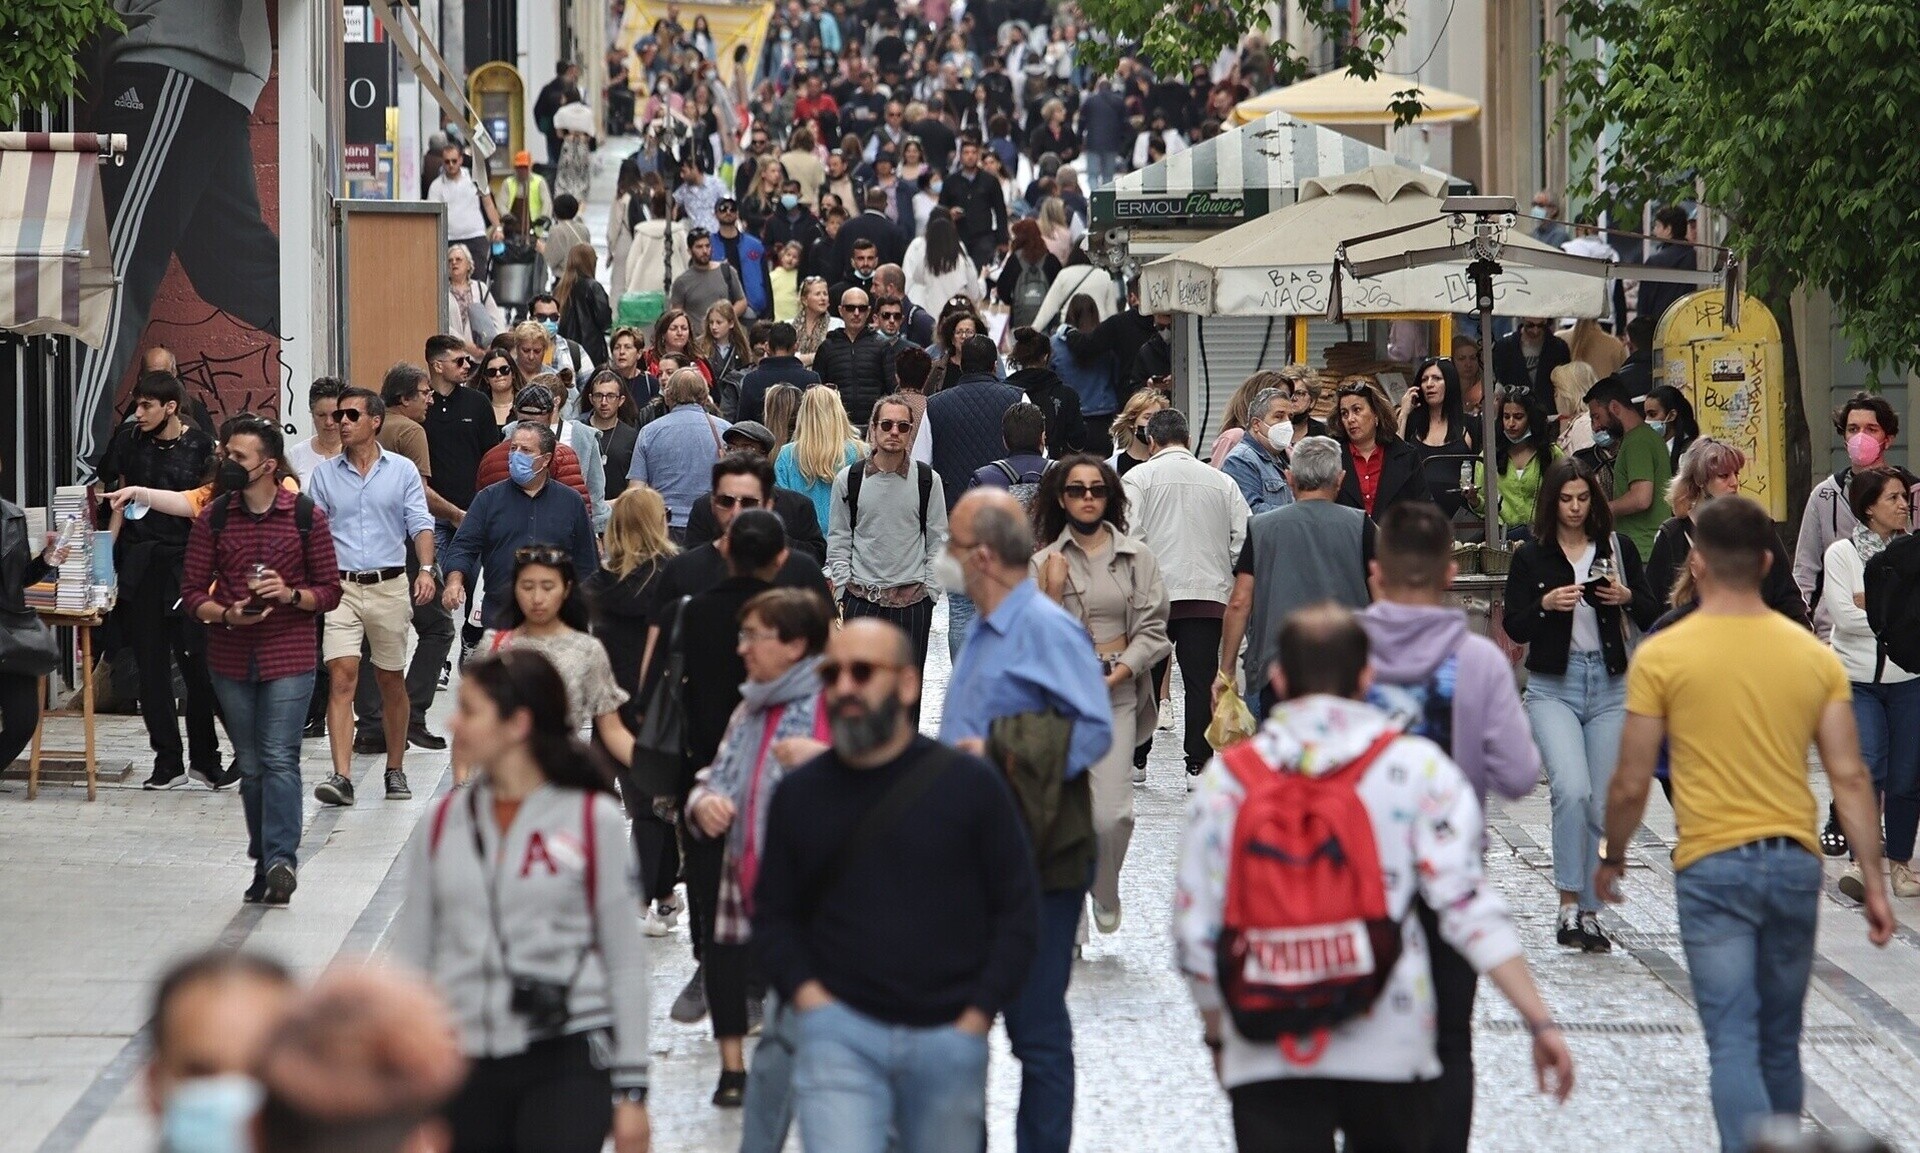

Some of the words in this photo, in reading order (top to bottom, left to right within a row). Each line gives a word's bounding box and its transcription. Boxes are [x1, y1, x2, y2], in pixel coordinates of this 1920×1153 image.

[114, 100, 144, 110] adidas
[1117, 201, 1182, 215] ERMOU
[1184, 193, 1242, 214] Flower
[519, 830, 558, 877] A
